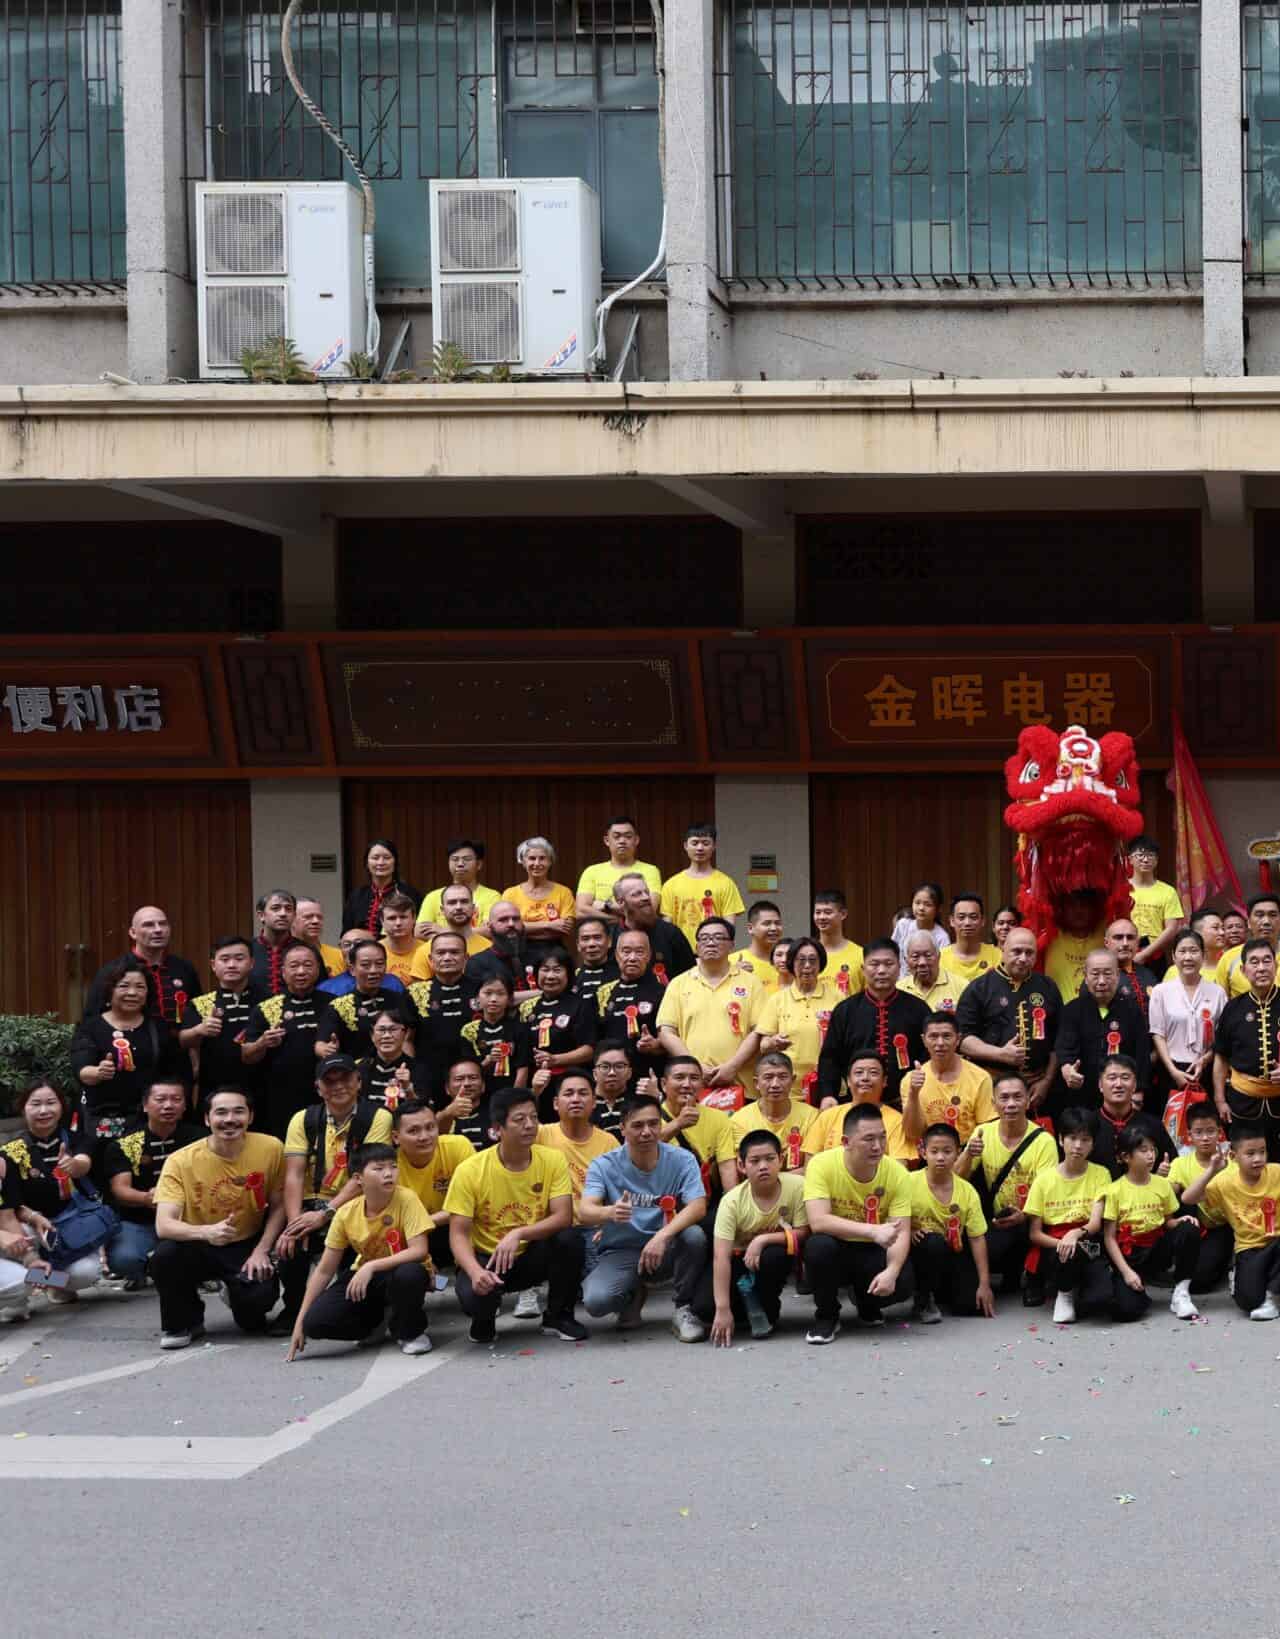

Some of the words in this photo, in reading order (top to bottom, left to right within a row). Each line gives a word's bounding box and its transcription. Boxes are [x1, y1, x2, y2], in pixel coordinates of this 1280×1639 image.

[3, 684, 162, 732] 便利店
[863, 671, 1117, 728] 金晖电器
